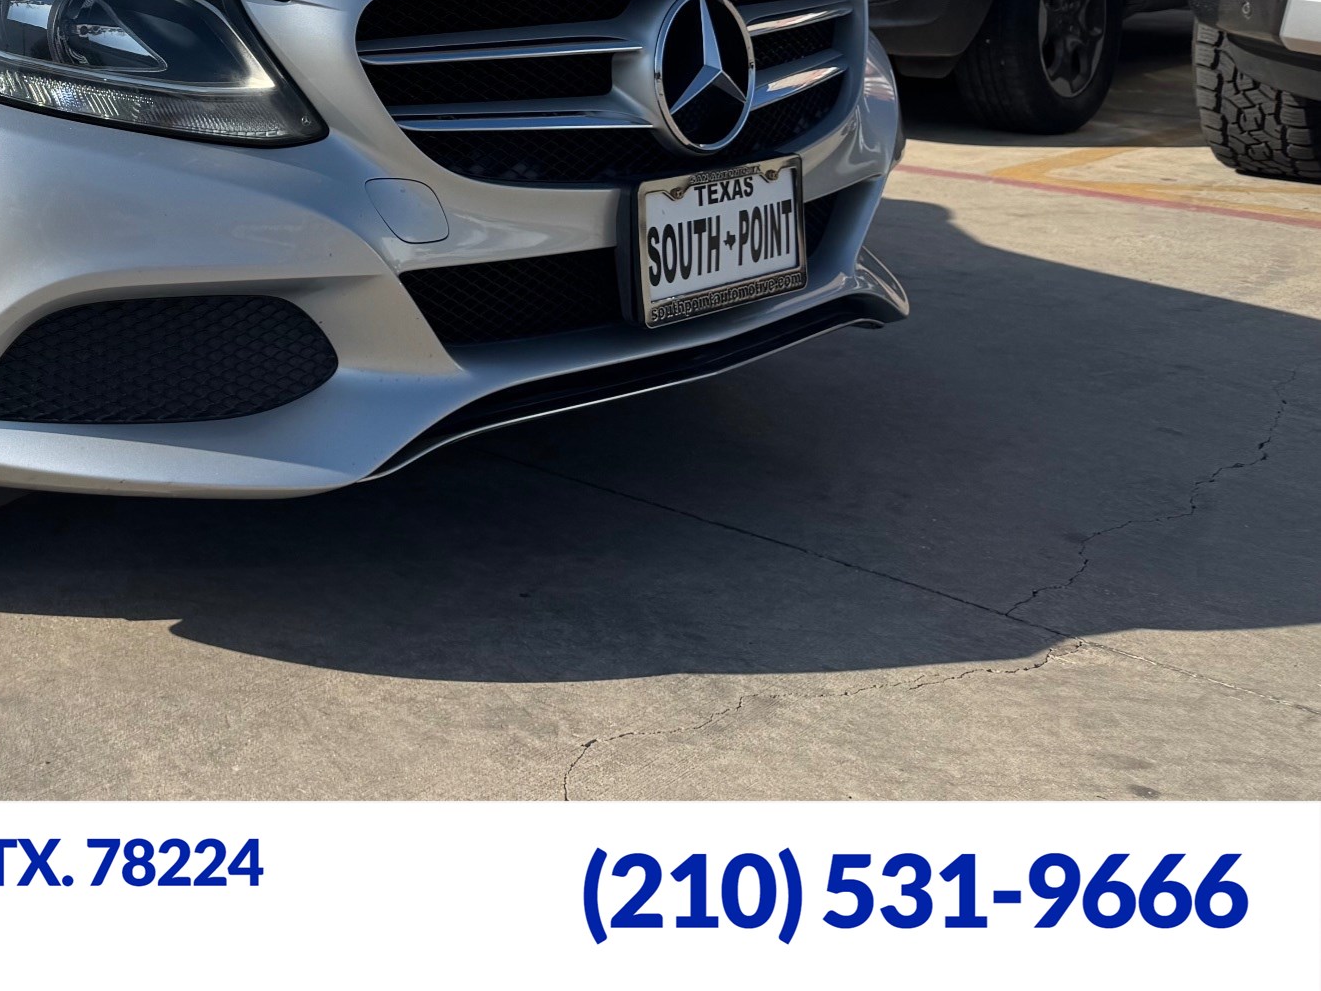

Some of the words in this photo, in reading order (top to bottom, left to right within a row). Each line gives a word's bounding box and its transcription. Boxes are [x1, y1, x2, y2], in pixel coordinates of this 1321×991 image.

[694, 176, 754, 207] TEXAS
[648, 215, 721, 287] SOUTH
[738, 198, 793, 266] POINT
[651, 272, 803, 323] southpointautomotive.com
